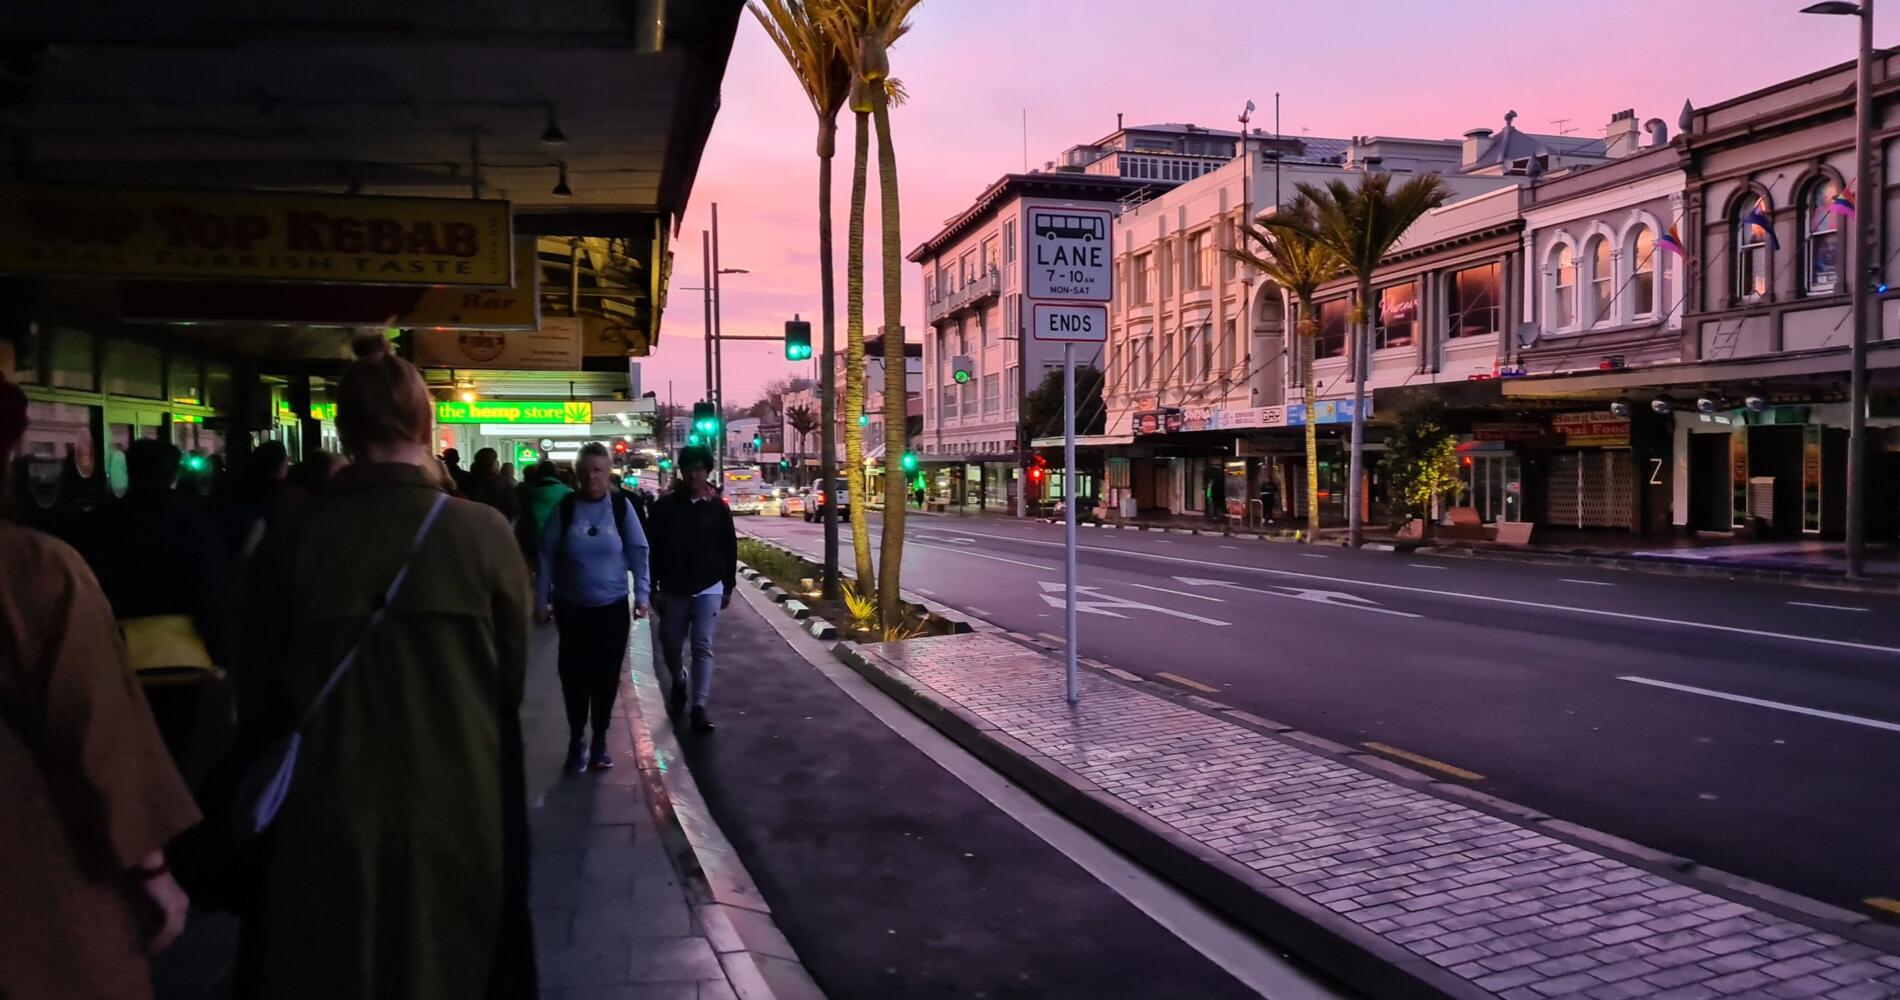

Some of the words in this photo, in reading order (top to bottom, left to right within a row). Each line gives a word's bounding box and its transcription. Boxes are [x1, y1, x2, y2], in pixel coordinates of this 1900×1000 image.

[284, 208, 479, 258] KEBAB
[153, 251, 332, 271] TURKISH
[353, 257, 472, 274] TASTE
[1037, 244, 1103, 267] LANE
[1049, 286, 1090, 295] MON-SAT
[460, 293, 517, 310] Bar
[1049, 314, 1092, 332] ENDS
[439, 402, 465, 418] the
[469, 404, 521, 421] hemp
[524, 406, 564, 418] store
[1555, 424, 1587, 434] Thai
[1592, 422, 1630, 433] Food
[1649, 458, 1663, 484] Z
